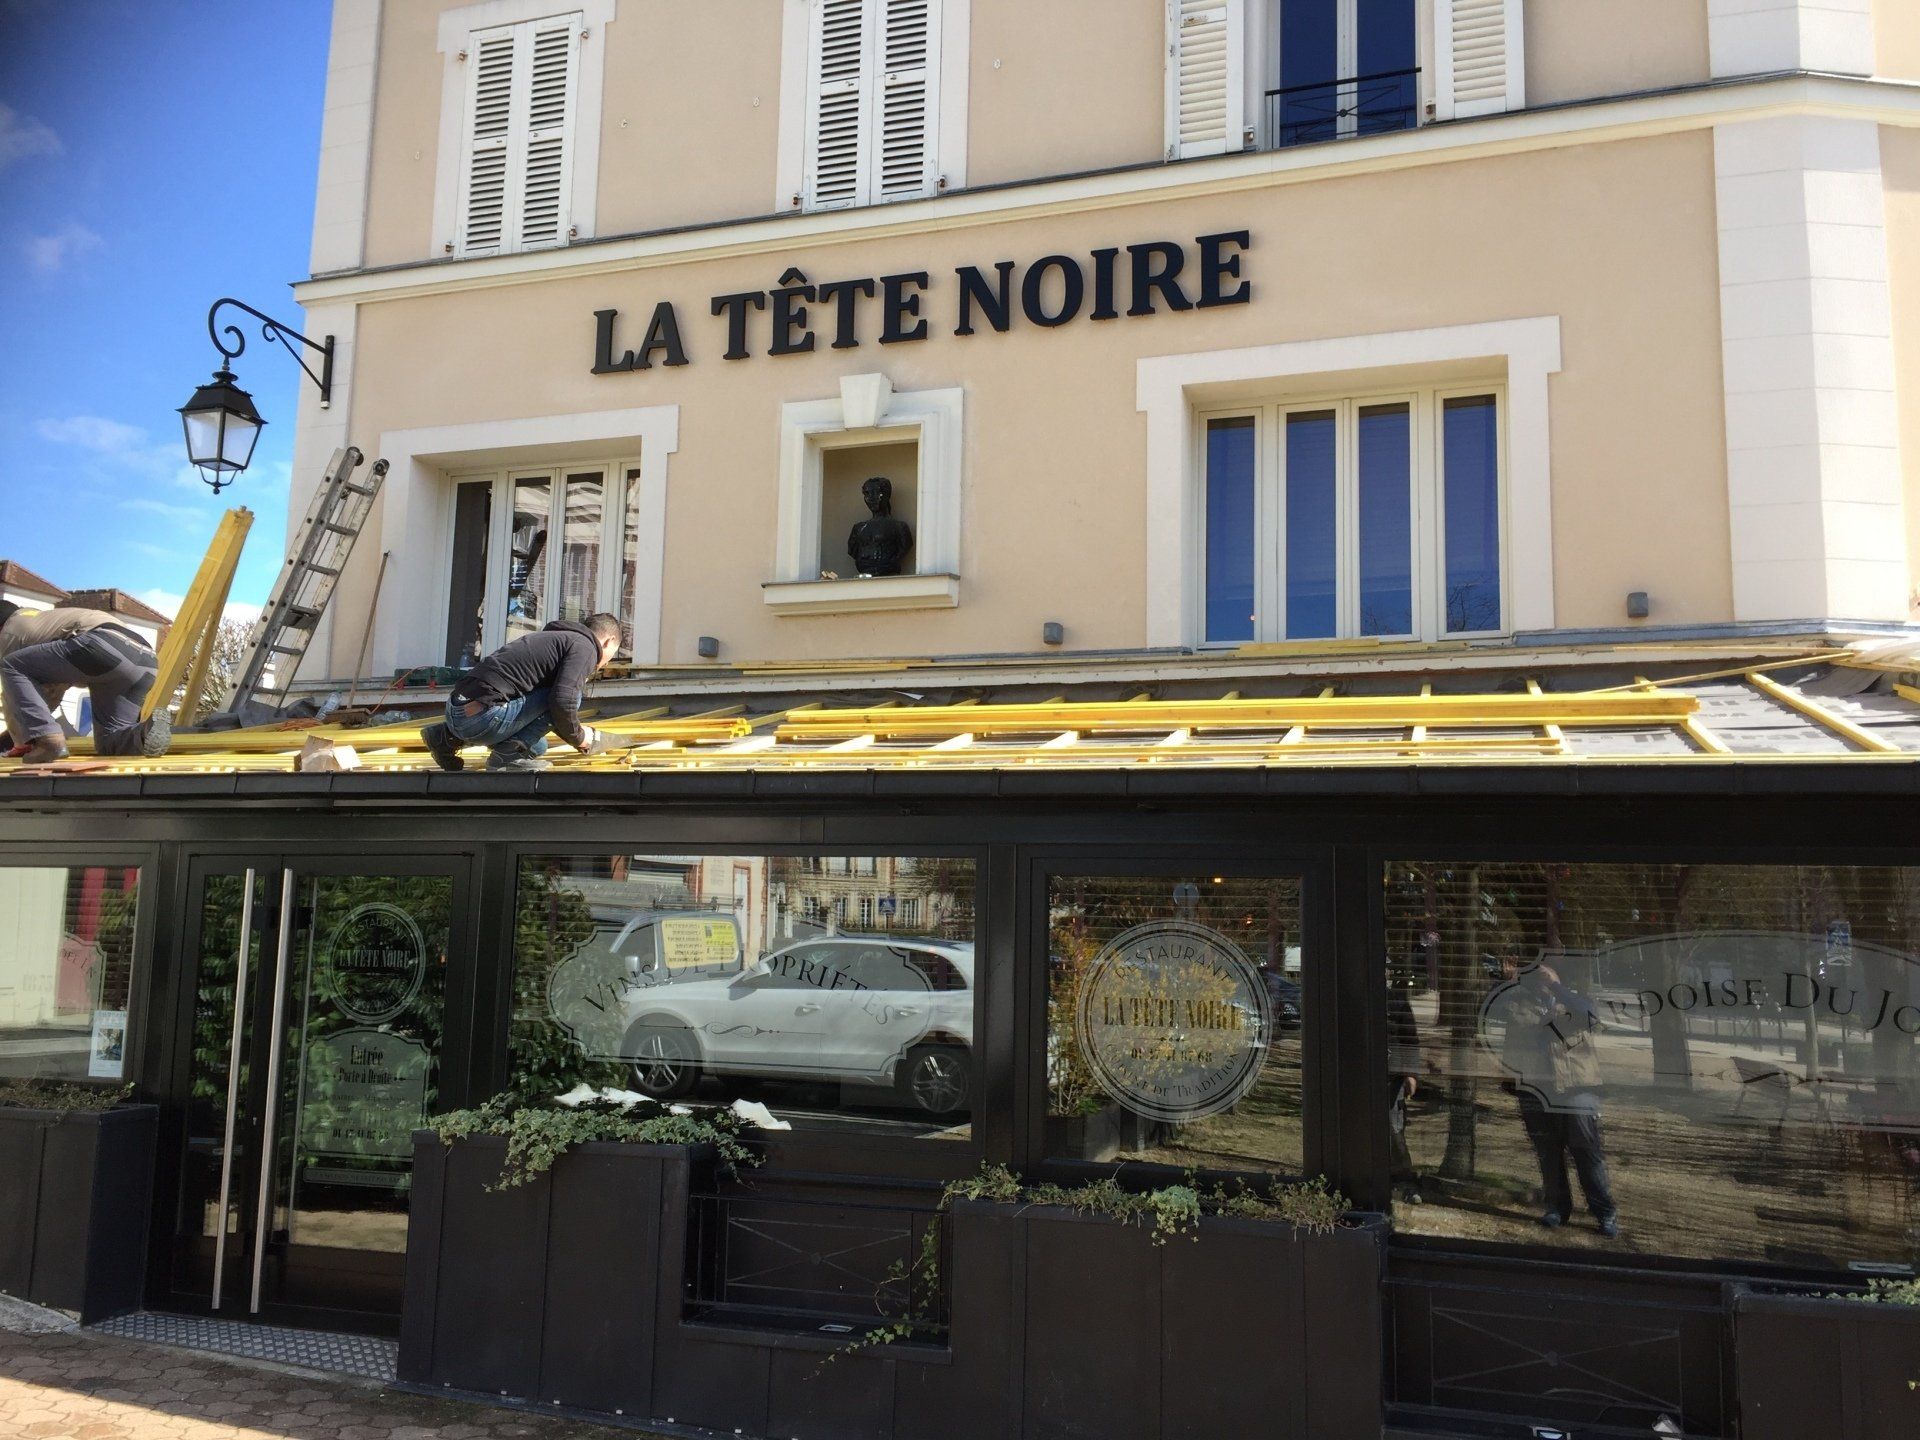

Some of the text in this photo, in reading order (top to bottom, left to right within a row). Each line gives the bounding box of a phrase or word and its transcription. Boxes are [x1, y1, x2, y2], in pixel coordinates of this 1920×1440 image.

[590, 230, 1250, 375] LA TÊTE NOIRE
[345, 918, 409, 941] RESTAURANT
[338, 948, 352, 967] LA
[382, 948, 411, 969] NOIRE
[1115, 943, 1233, 980] RESTAURANT
[581, 963, 655, 1012] VINS
[1103, 996, 1127, 1026] LA
[1185, 999, 1241, 1031] NOIRE
[1546, 978, 1767, 1050] L'ARDOISE
[1782, 971, 1859, 1016] DU
[350, 1044, 384, 1066] Entrée
[1197, 1052, 1213, 1064] 68
[338, 1067, 360, 1082] Porte
[1173, 1052, 1240, 1098] TRADITION
